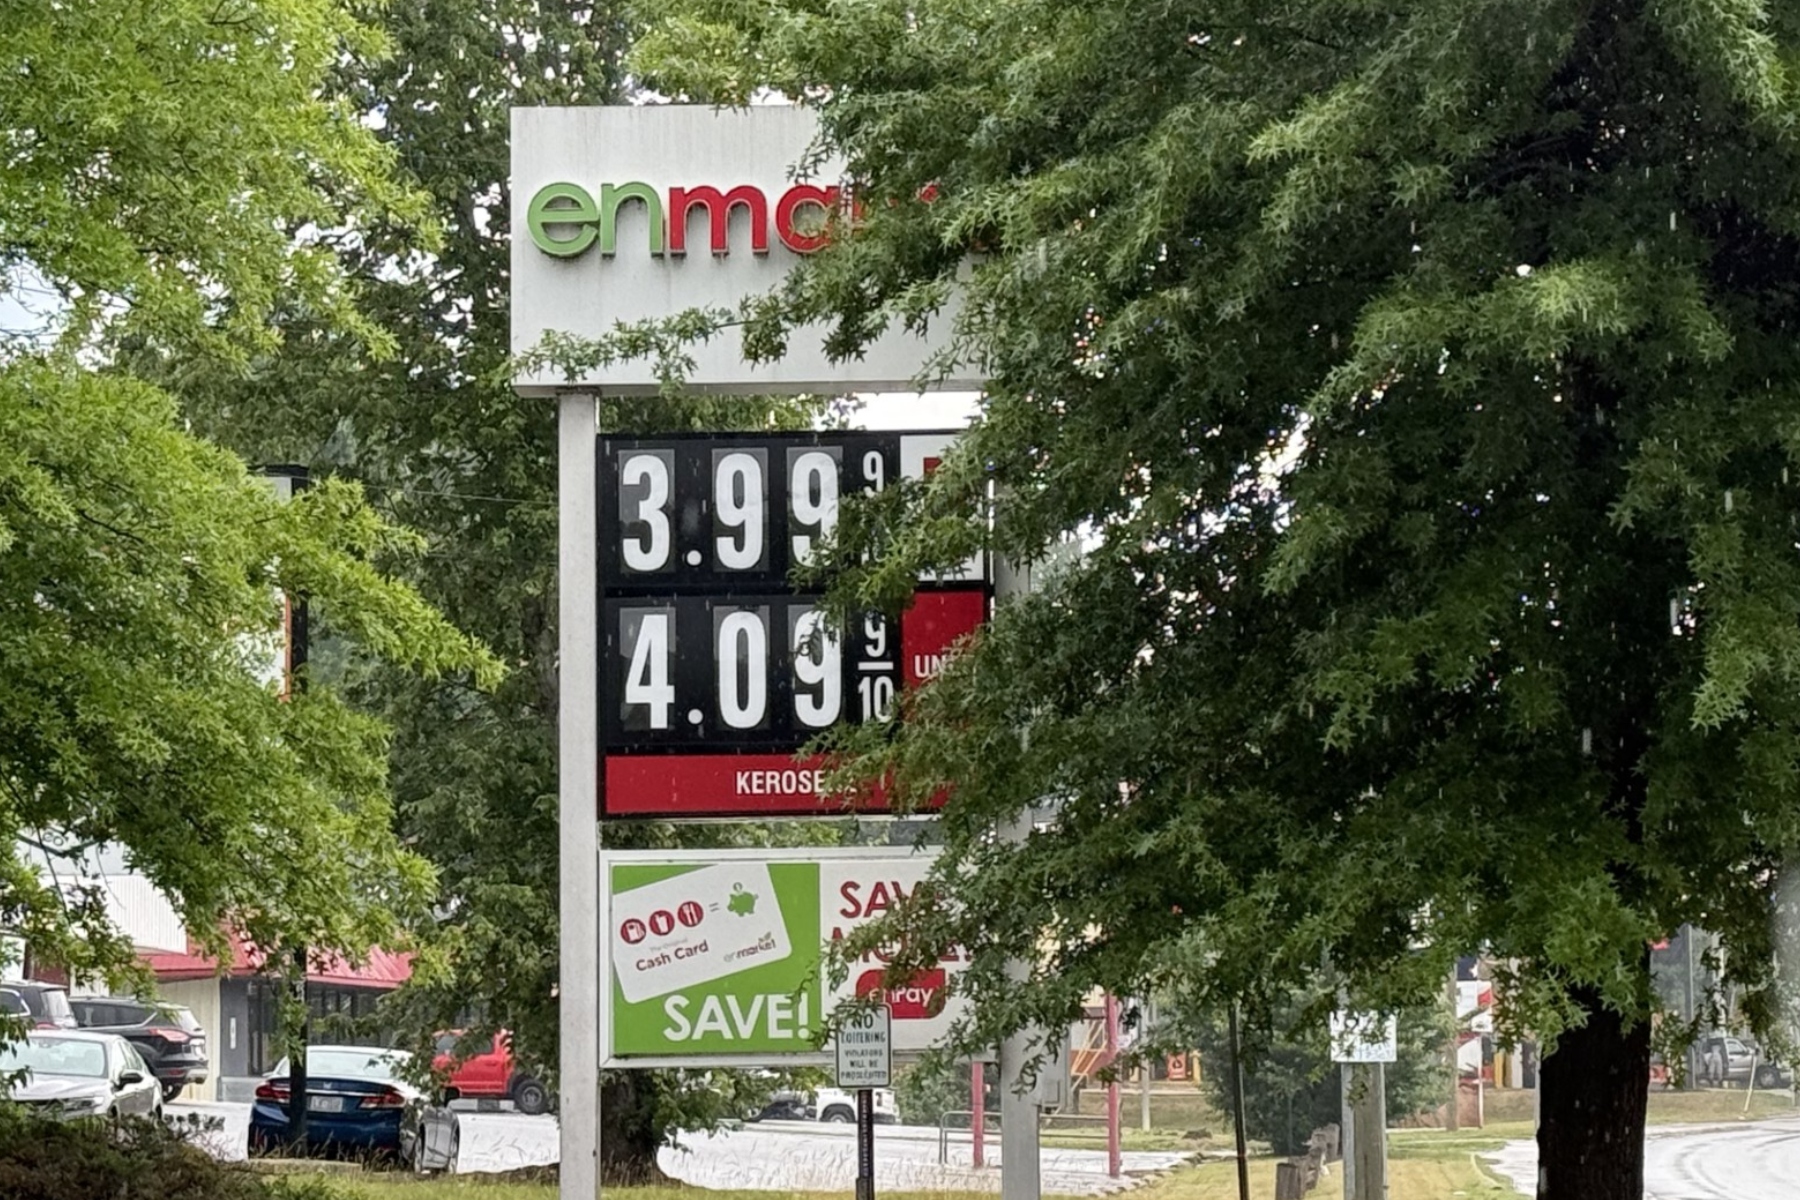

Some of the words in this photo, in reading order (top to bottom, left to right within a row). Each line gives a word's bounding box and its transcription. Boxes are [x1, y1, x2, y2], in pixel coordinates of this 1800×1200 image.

[527, 182, 920, 257] enma
[622, 452, 839, 572] 3.99
[863, 450, 884, 498] 9
[626, 610, 842, 729] 4.09
[864, 609, 886, 657] 9
[858, 675, 894, 723] 10
[736, 770, 857, 795] KEROSE
[840, 880, 942, 918] SAV
[636, 952, 672, 972] Cash
[674, 938, 709, 960] Card
[663, 994, 811, 1041] SAVE!
